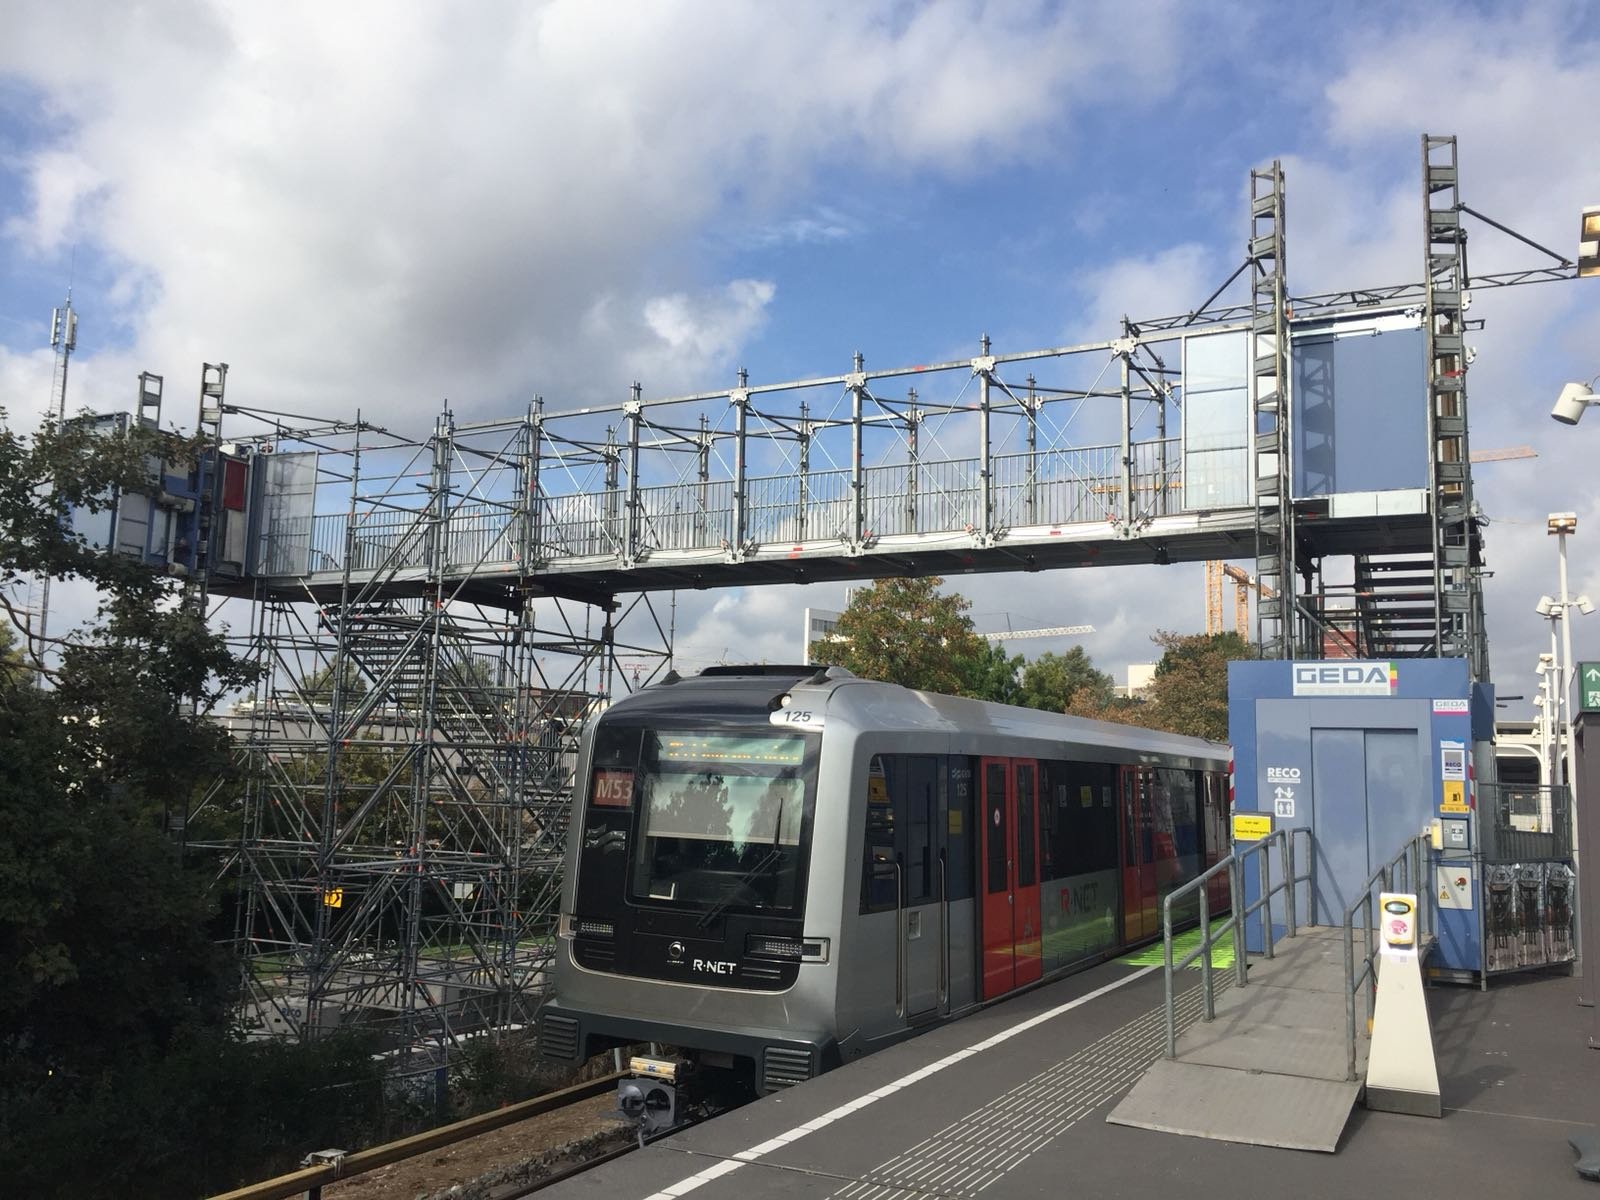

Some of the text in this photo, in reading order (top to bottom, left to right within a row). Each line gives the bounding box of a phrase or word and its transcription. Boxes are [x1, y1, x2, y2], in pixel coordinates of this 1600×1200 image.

[1296, 667, 1388, 684] GEDA
[784, 710, 812, 723] 125
[1267, 767, 1301, 778] RECO
[596, 777, 633, 800] M53
